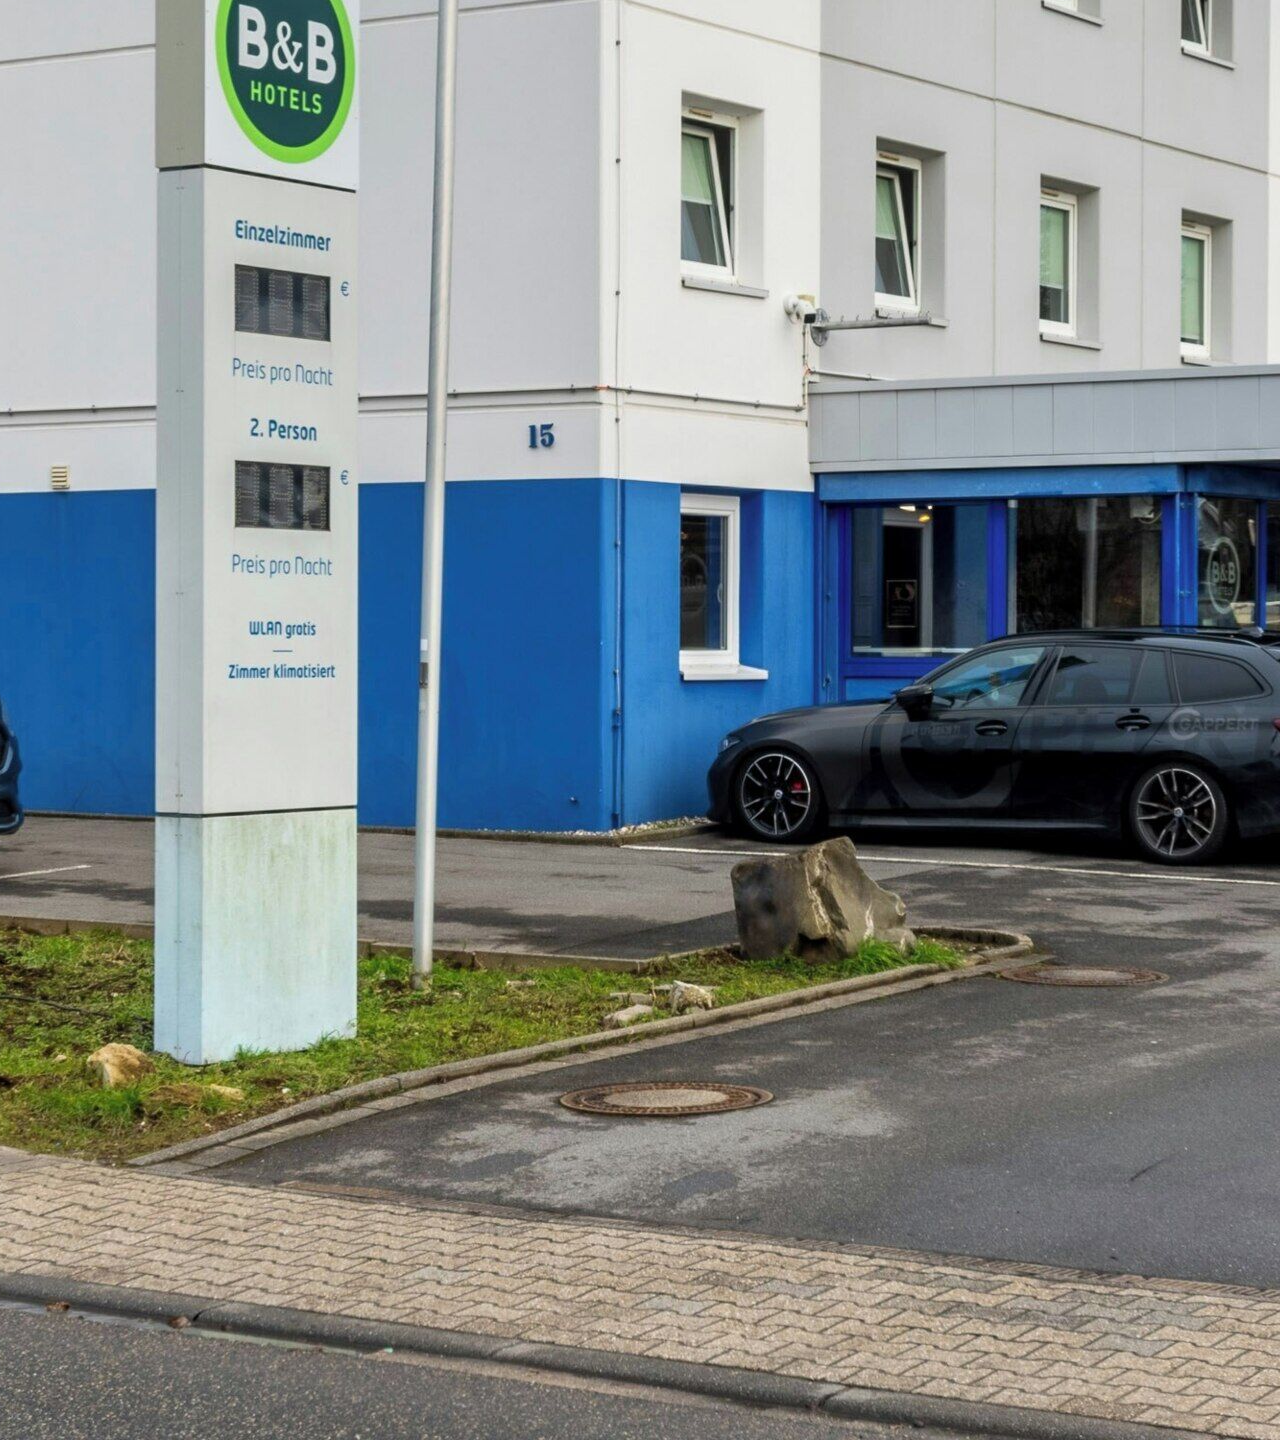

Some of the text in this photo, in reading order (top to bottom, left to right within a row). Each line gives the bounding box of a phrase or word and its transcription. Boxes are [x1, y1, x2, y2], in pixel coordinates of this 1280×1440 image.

[238, 3, 337, 85] B&B
[250, 80, 322, 114] HOTELS
[235, 219, 331, 251] Einzelzimmer
[340, 281, 350, 297] €
[232, 357, 333, 386] Preis pro Nacht
[250, 418, 318, 441] 2. Person
[528, 423, 555, 449] 15
[340, 469, 349, 486] €
[232, 553, 333, 578] Preis pro Nacht
[1212, 561, 1236, 584] B&B
[249, 621, 316, 639] WLAN gratis
[228, 664, 336, 679] Zimmer klimatisiert
